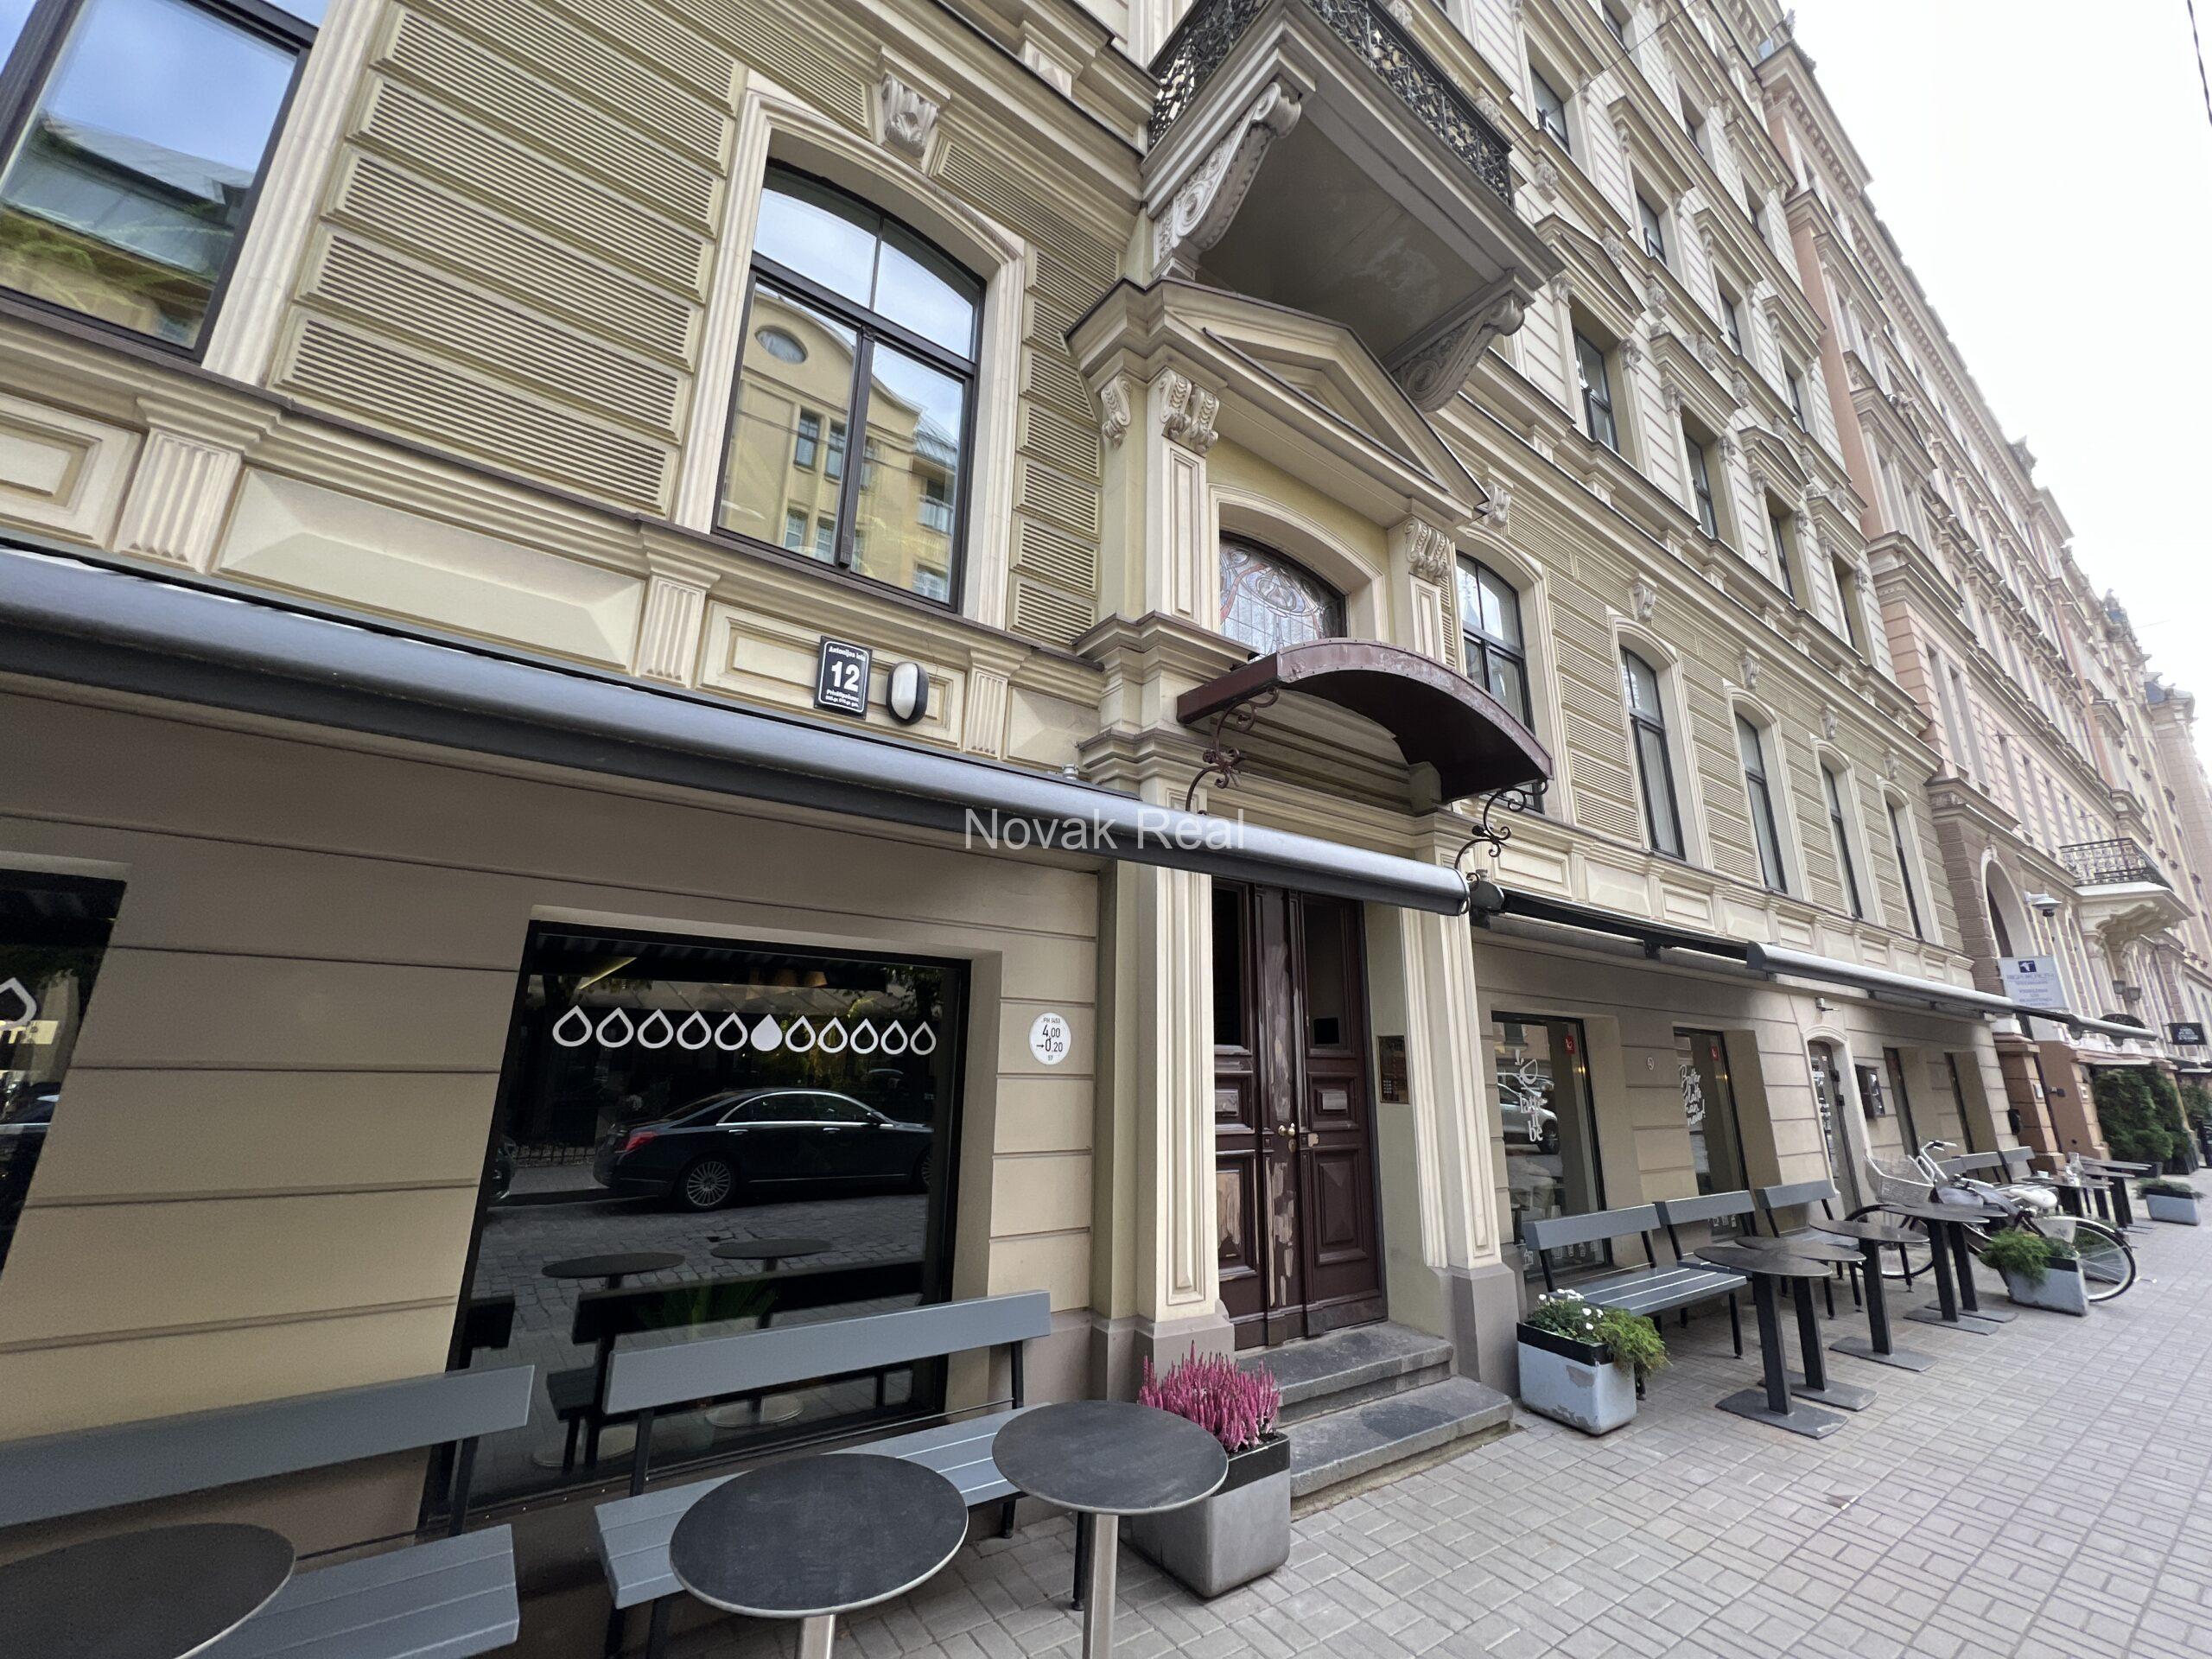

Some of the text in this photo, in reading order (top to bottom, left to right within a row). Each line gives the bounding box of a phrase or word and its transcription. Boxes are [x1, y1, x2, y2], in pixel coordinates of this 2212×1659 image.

[829, 645, 855, 658] Antonijas
[832, 660, 860, 692] 12
[1527, 1120, 1543, 1141] be
